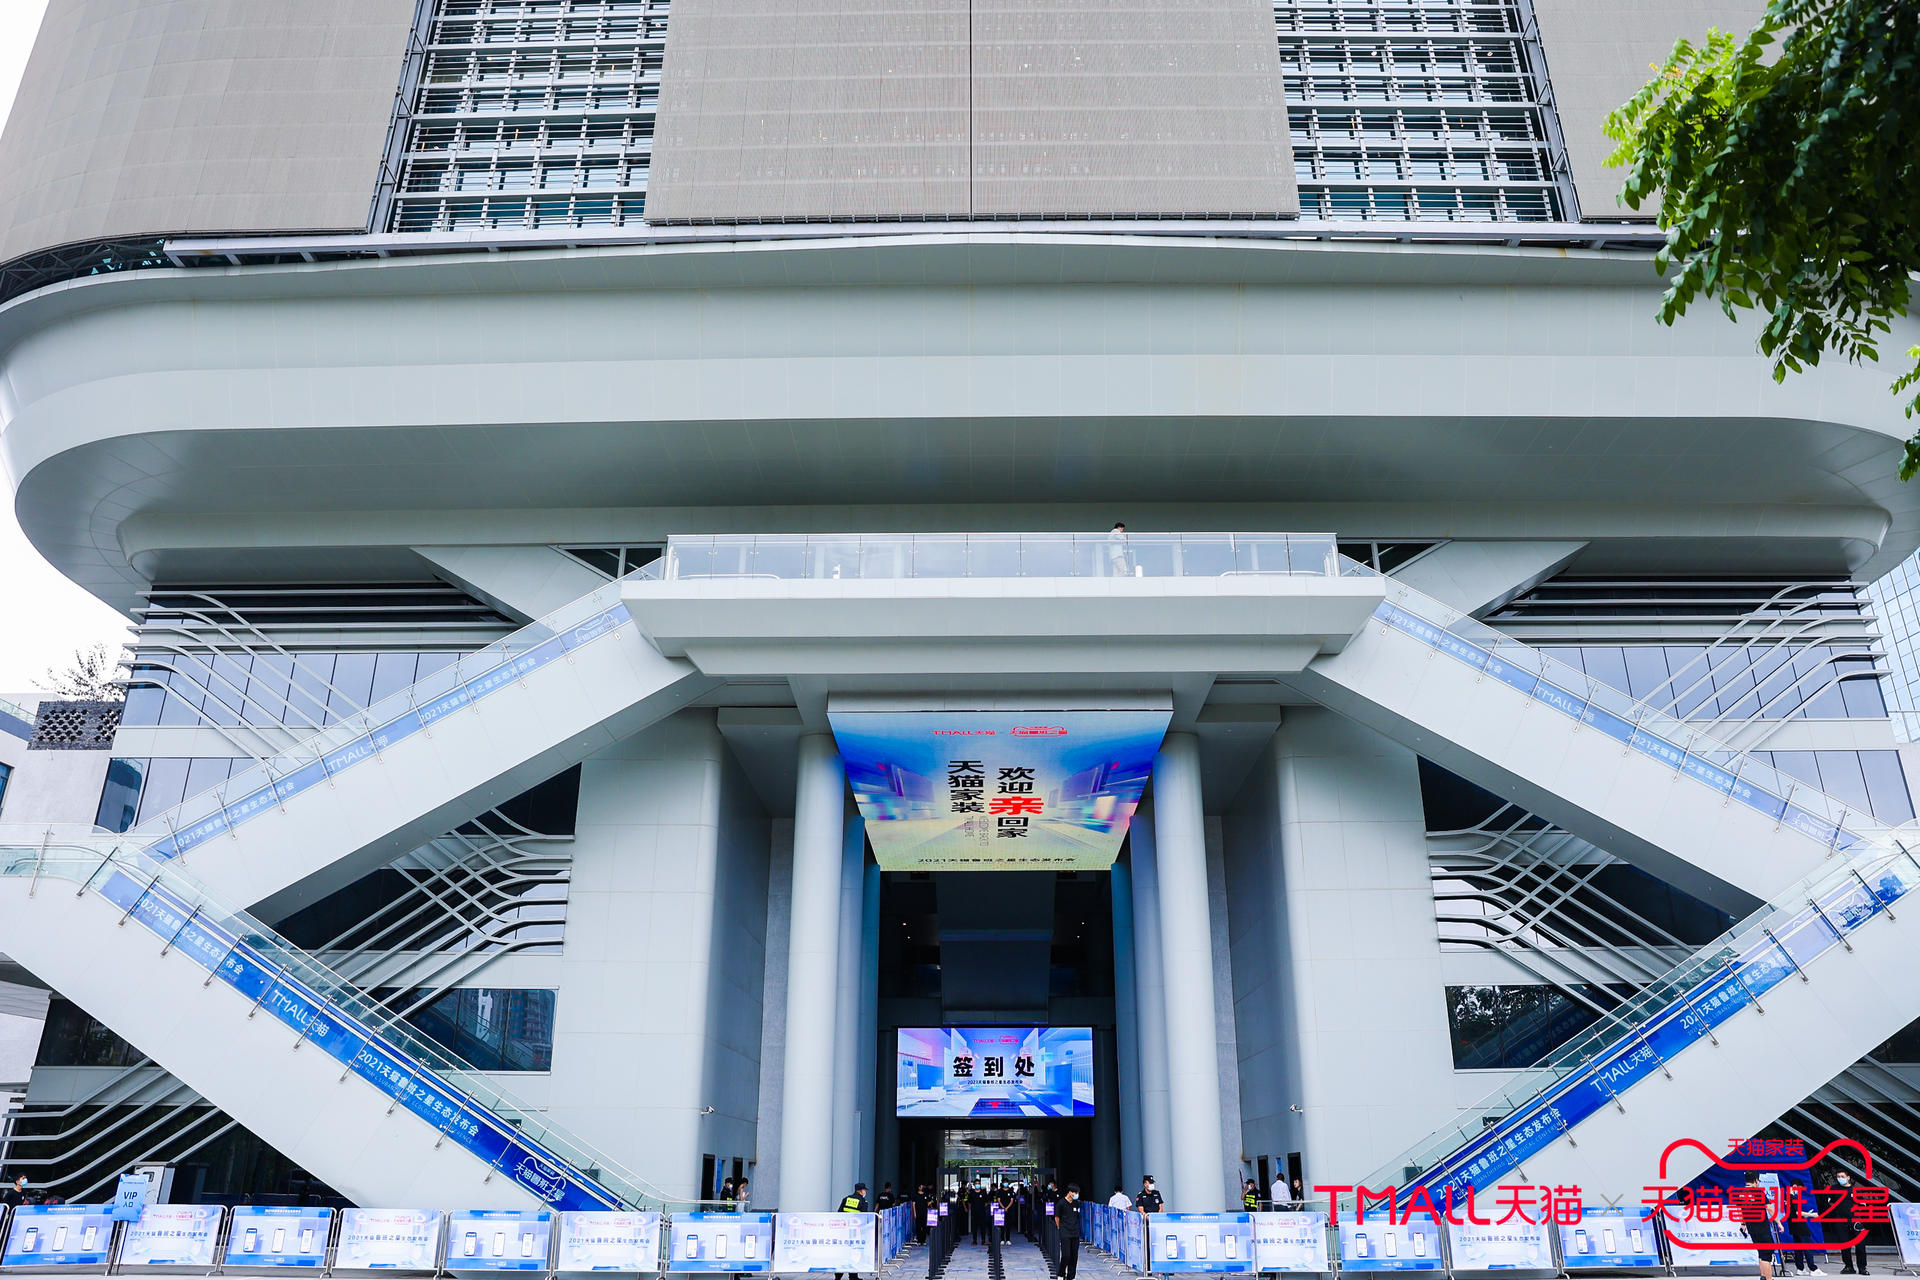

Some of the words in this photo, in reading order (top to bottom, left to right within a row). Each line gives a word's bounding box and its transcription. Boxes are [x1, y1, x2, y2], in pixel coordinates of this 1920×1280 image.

[948, 760, 985, 814] 天猫家装
[989, 766, 1045, 839] 欢迎亲回家
[271, 989, 329, 1037] TMALL天猫
[953, 1056, 1035, 1077] 签到处
[1590, 1044, 1653, 1092] TMALL天猫
[357, 1049, 480, 1137] 2021天猫鲁班之星生态发布会
[1435, 1105, 1562, 1199] 2021天猫鲁班之星生态发布会
[123, 1191, 138, 1200] VIP
